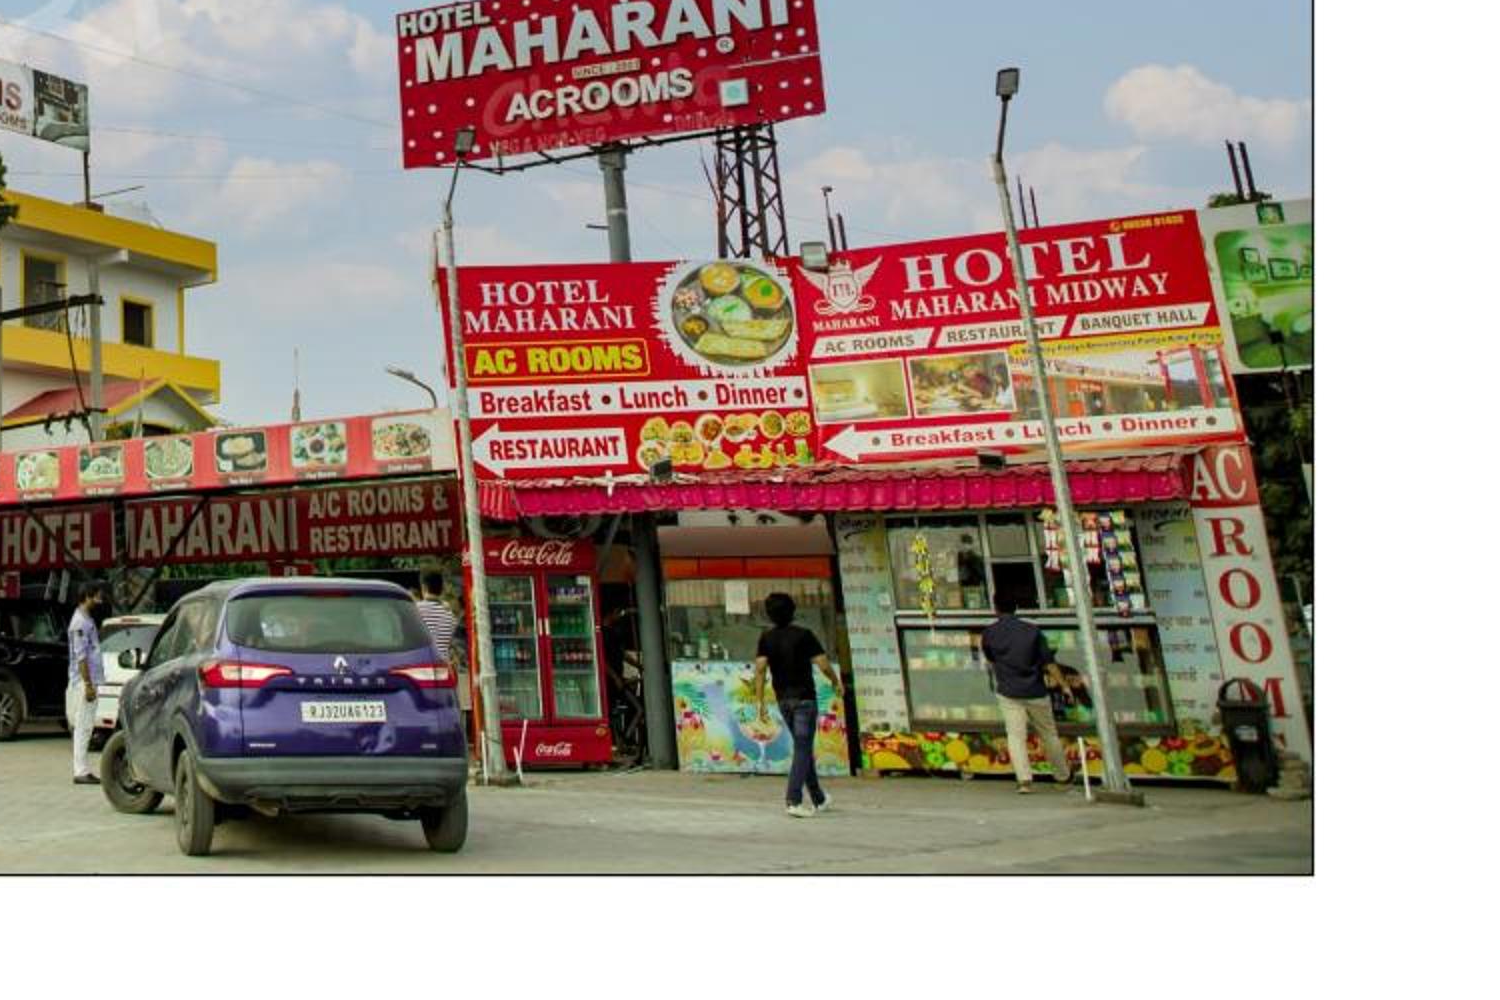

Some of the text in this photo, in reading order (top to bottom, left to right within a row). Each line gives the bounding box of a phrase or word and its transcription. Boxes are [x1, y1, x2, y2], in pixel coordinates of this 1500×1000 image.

[399, 1, 491, 38] HOTEL
[899, 232, 1152, 293] HOTEL
[480, 280, 610, 307] HOTEL
[890, 272, 1169, 321] MAHARANI MIDWAY
[464, 305, 636, 334] MAHARANI
[812, 316, 880, 332] MAHARANI
[947, 321, 1055, 343] RESTAURNT
[1081, 307, 1198, 331] BANQUET HALL
[474, 344, 643, 375] AC ROOMS
[825, 334, 916, 354] AC ROOMS
[479, 383, 788, 415] Breakfast Lunch Dinner
[891, 426, 996, 447] Breakfast
[1121, 414, 1198, 433] Dinner
[489, 434, 620, 461] RESTAURANT
[1191, 447, 1248, 500] AC
[308, 484, 449, 518] A/C ROOMS &
[2, 510, 100, 565] HOTEL
[309, 520, 453, 553] RESTAURANT
[1204, 517, 1293, 752] ROOM
